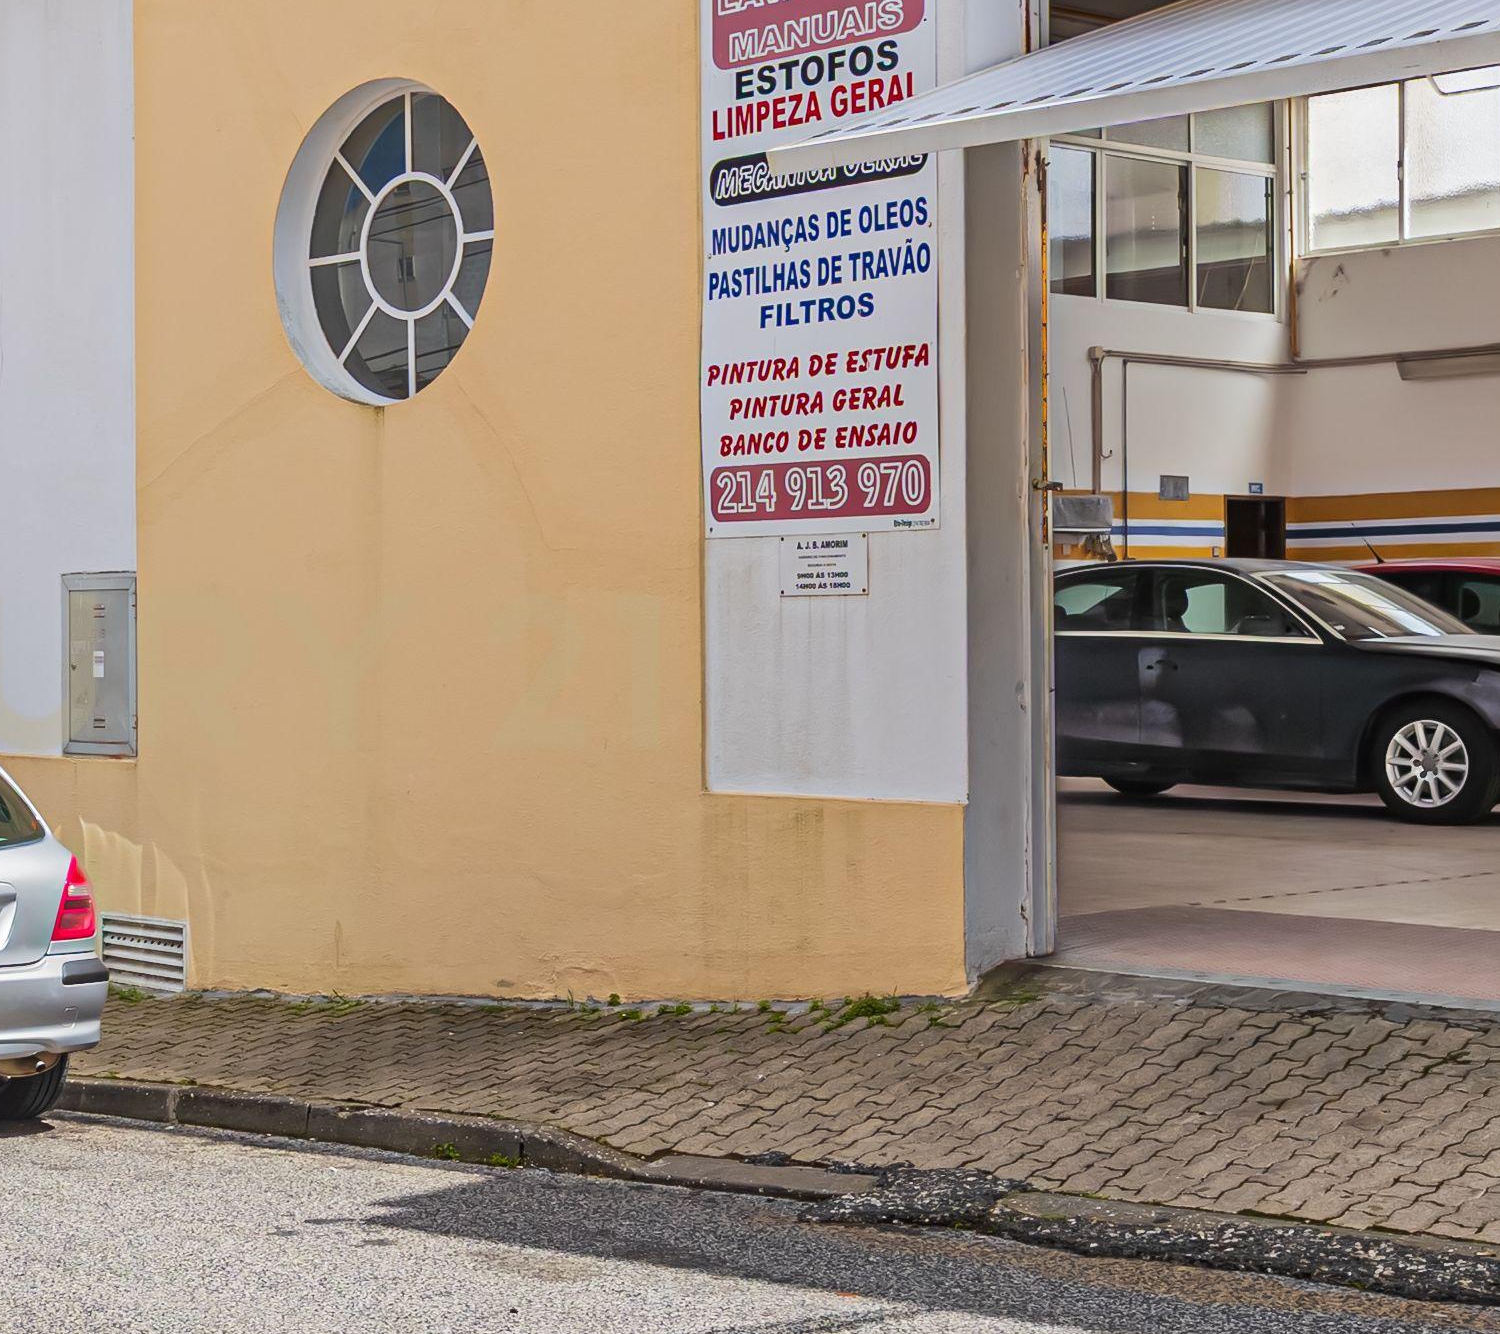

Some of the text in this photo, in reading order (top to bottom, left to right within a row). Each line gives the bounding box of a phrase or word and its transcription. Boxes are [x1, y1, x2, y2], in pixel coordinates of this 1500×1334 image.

[735, 39, 899, 100] ESTOFOS
[712, 90, 822, 141] LIMPEZA
[712, 196, 928, 255] MUDANÇAS DE OLEOS
[709, 238, 931, 300] PASTILHAS DE TRAVÃO
[760, 292, 875, 329] FILTROS
[707, 343, 930, 387] PINTURA DE ESTUFA
[729, 384, 905, 420] PINTURA GERAL
[719, 421, 918, 457] BANCO DE ENSAIO
[717, 459, 925, 514] 214 913 970
[820, 540, 848, 549] AMORIM
